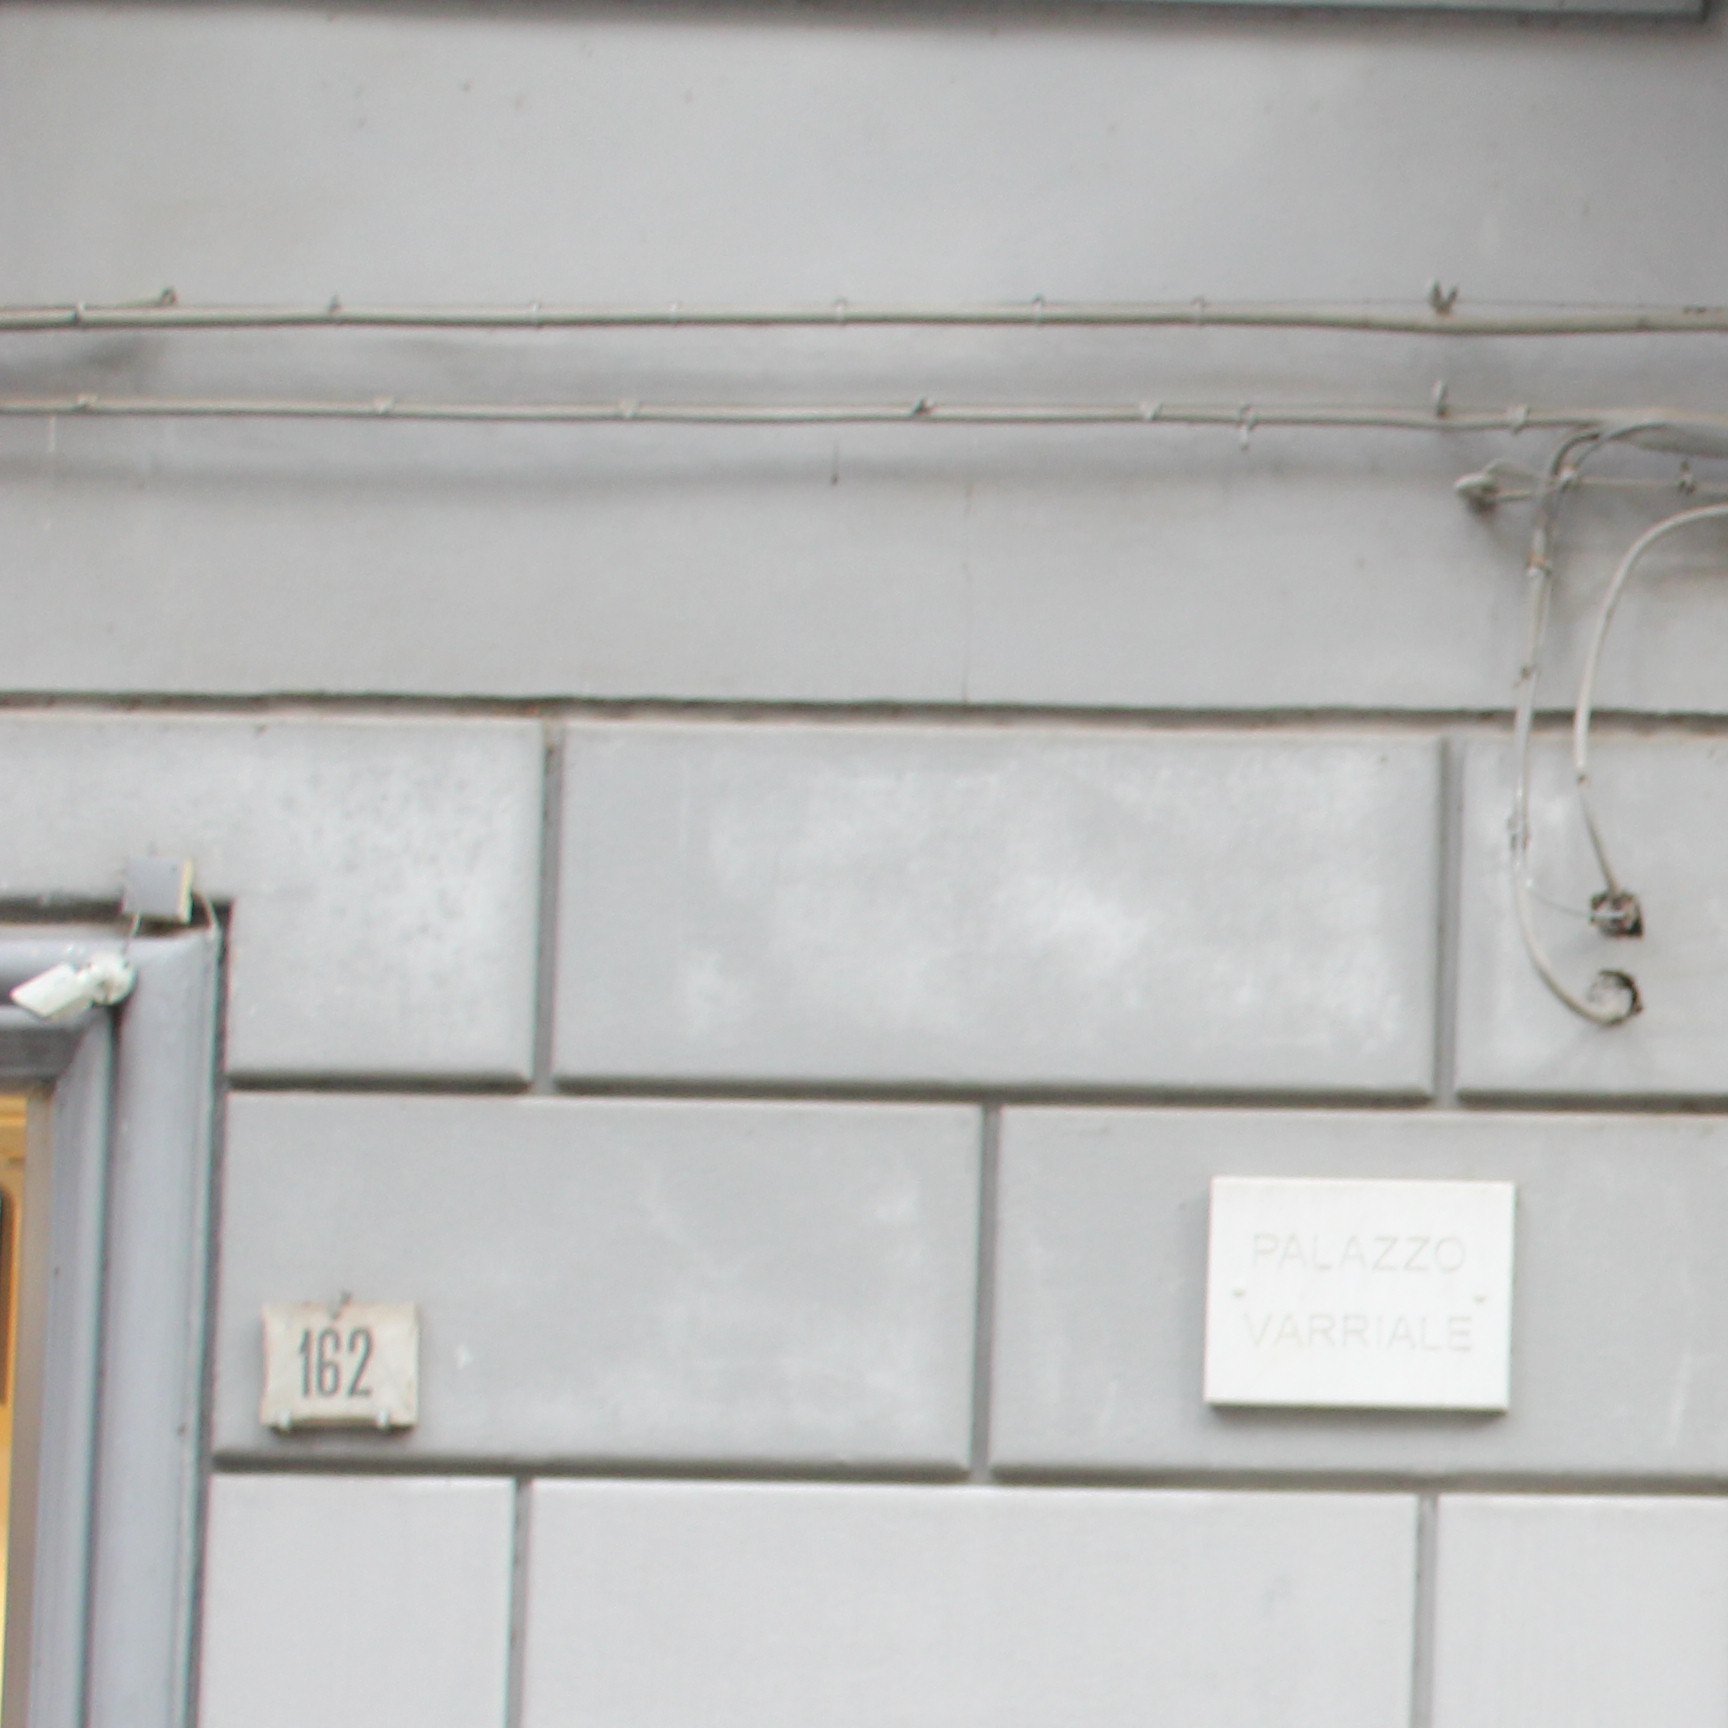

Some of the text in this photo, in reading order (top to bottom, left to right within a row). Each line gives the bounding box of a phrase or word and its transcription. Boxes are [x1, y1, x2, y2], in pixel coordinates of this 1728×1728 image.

[1252, 1231, 1466, 1273] PALAZZO
[1243, 1312, 1473, 1352] VARRIALE
[299, 1326, 374, 1397] 162
